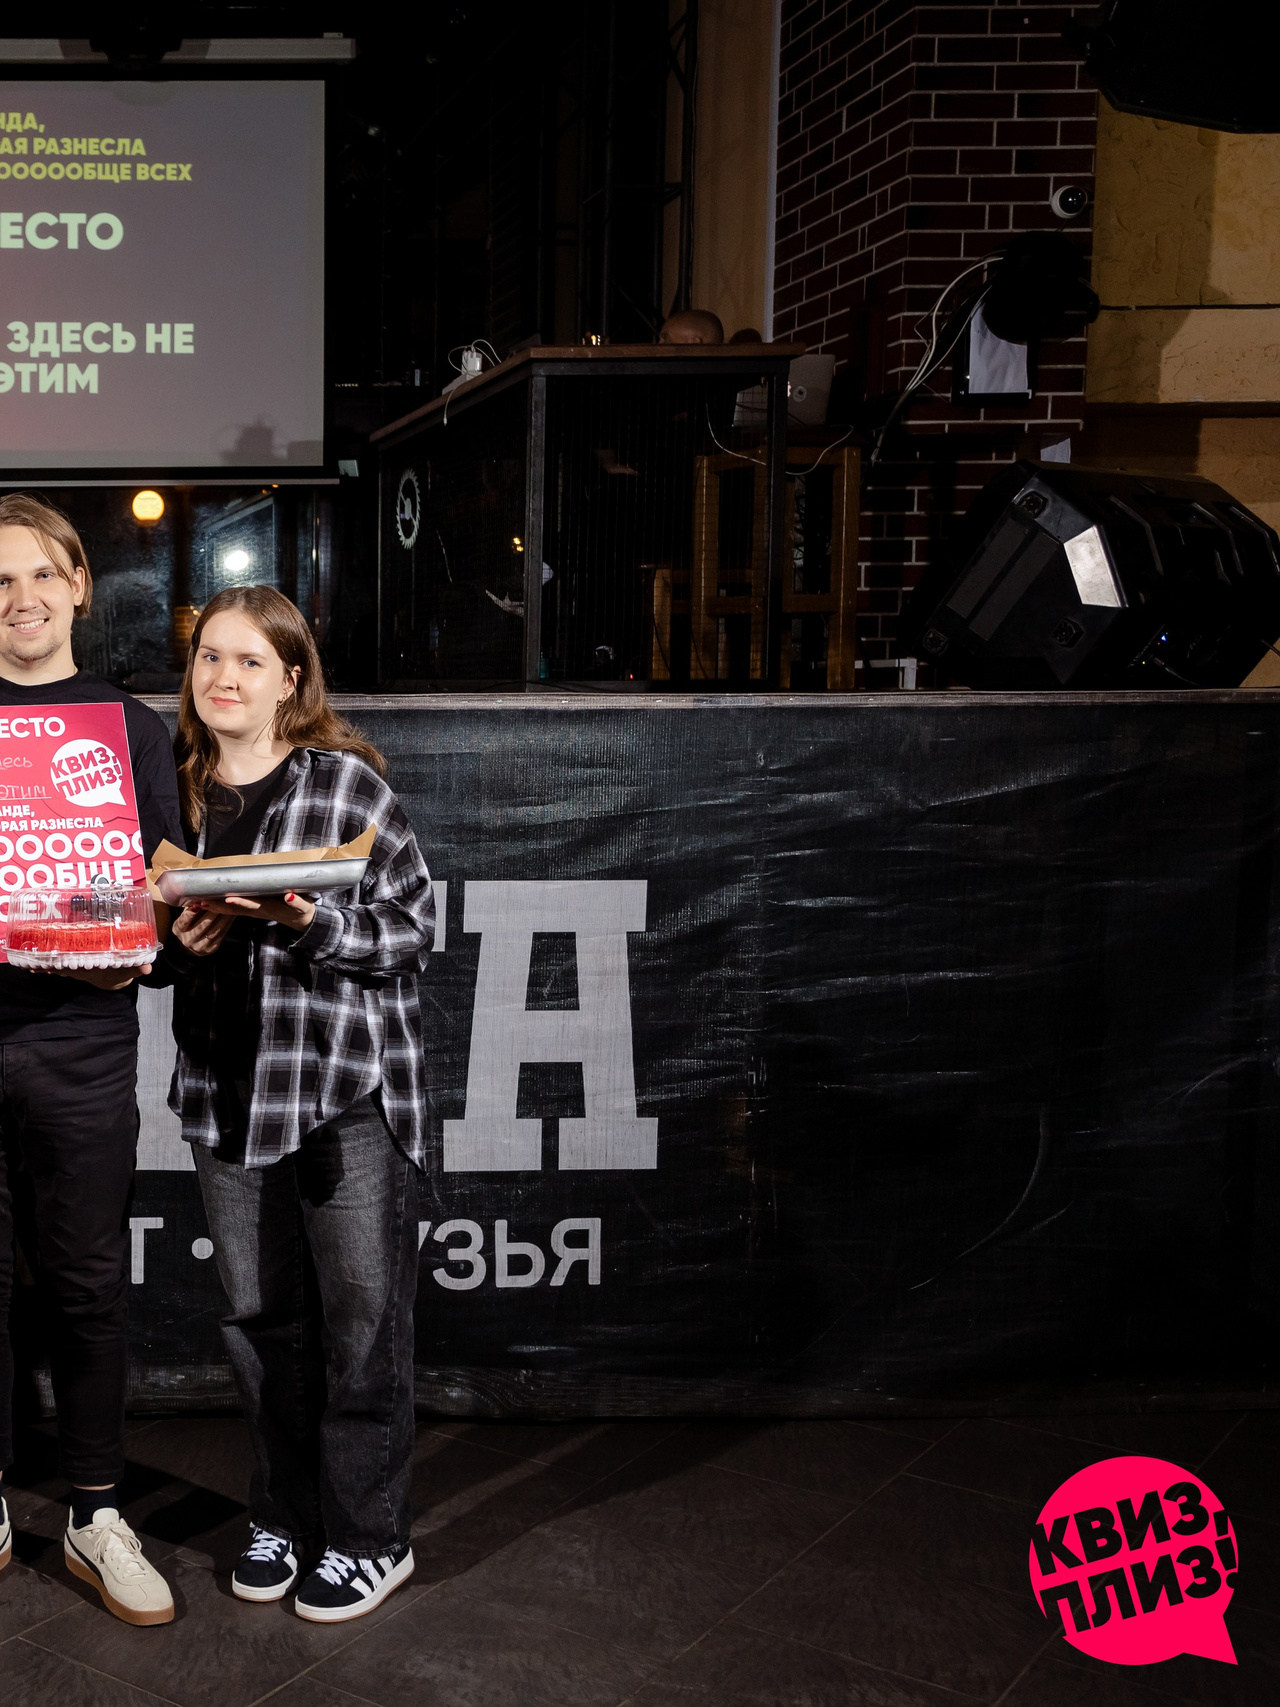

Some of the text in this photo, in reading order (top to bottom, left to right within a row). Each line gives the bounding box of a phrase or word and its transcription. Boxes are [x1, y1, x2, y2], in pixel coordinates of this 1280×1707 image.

[33, 138, 147, 156] РАЗНЕСЛА
[136, 163, 192, 181] ВСЕХ
[6, 321, 136, 358] ЗДЕСЬ
[145, 323, 195, 354] НЕ
[31, 817, 104, 831] РАЗНЕСЛА
